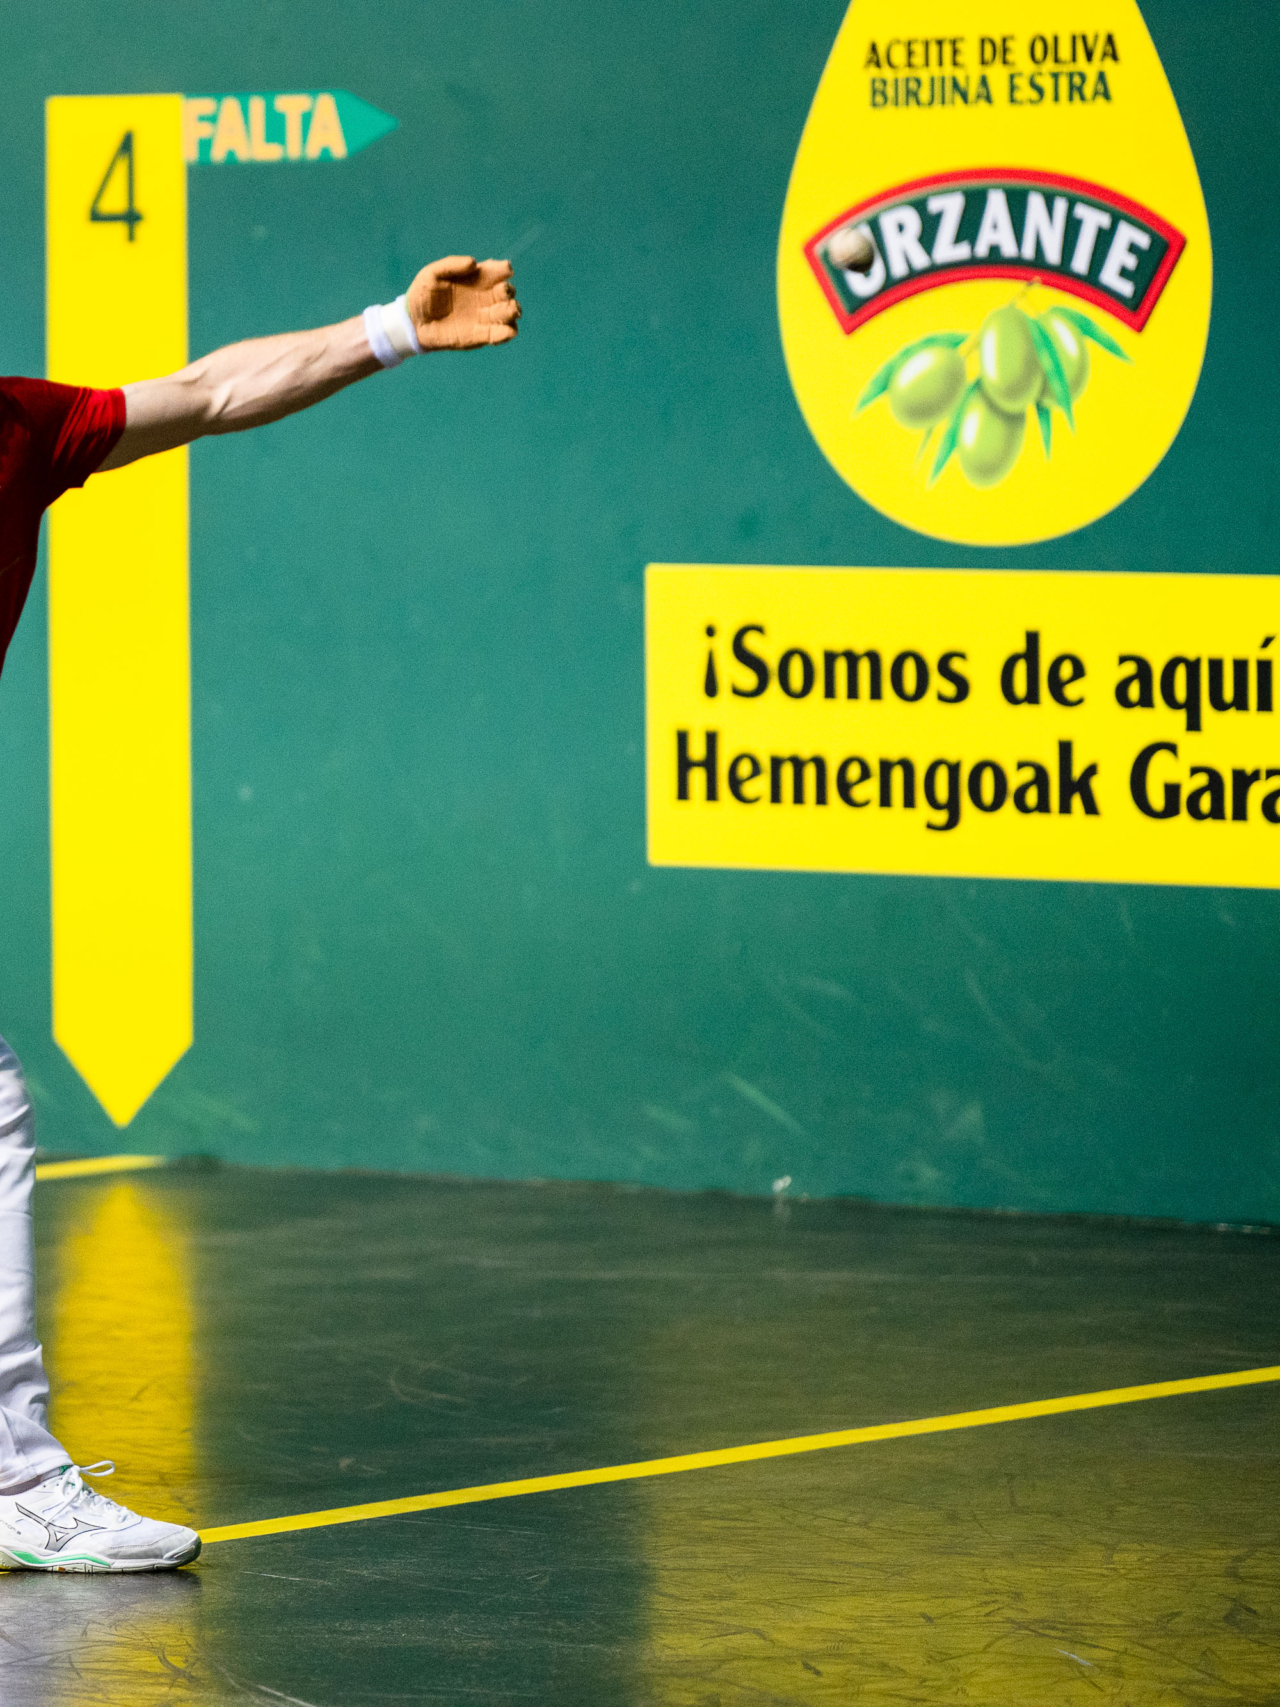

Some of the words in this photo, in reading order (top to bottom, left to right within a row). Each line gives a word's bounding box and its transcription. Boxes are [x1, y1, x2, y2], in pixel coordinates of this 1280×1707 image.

[864, 37, 966, 69] ACEITE
[979, 36, 1015, 66] DE
[1029, 32, 1121, 65] OLIVA
[870, 74, 993, 109] BIRJINA
[1008, 70, 1113, 105] ESTRA
[182, 93, 348, 162] FALTA
[89, 130, 144, 242] 4
[703, 623, 971, 704] ¡Somos
[999, 629, 1087, 708] de
[1113, 635, 1277, 733] aquí
[676, 729, 1101, 832] Hemengoak
